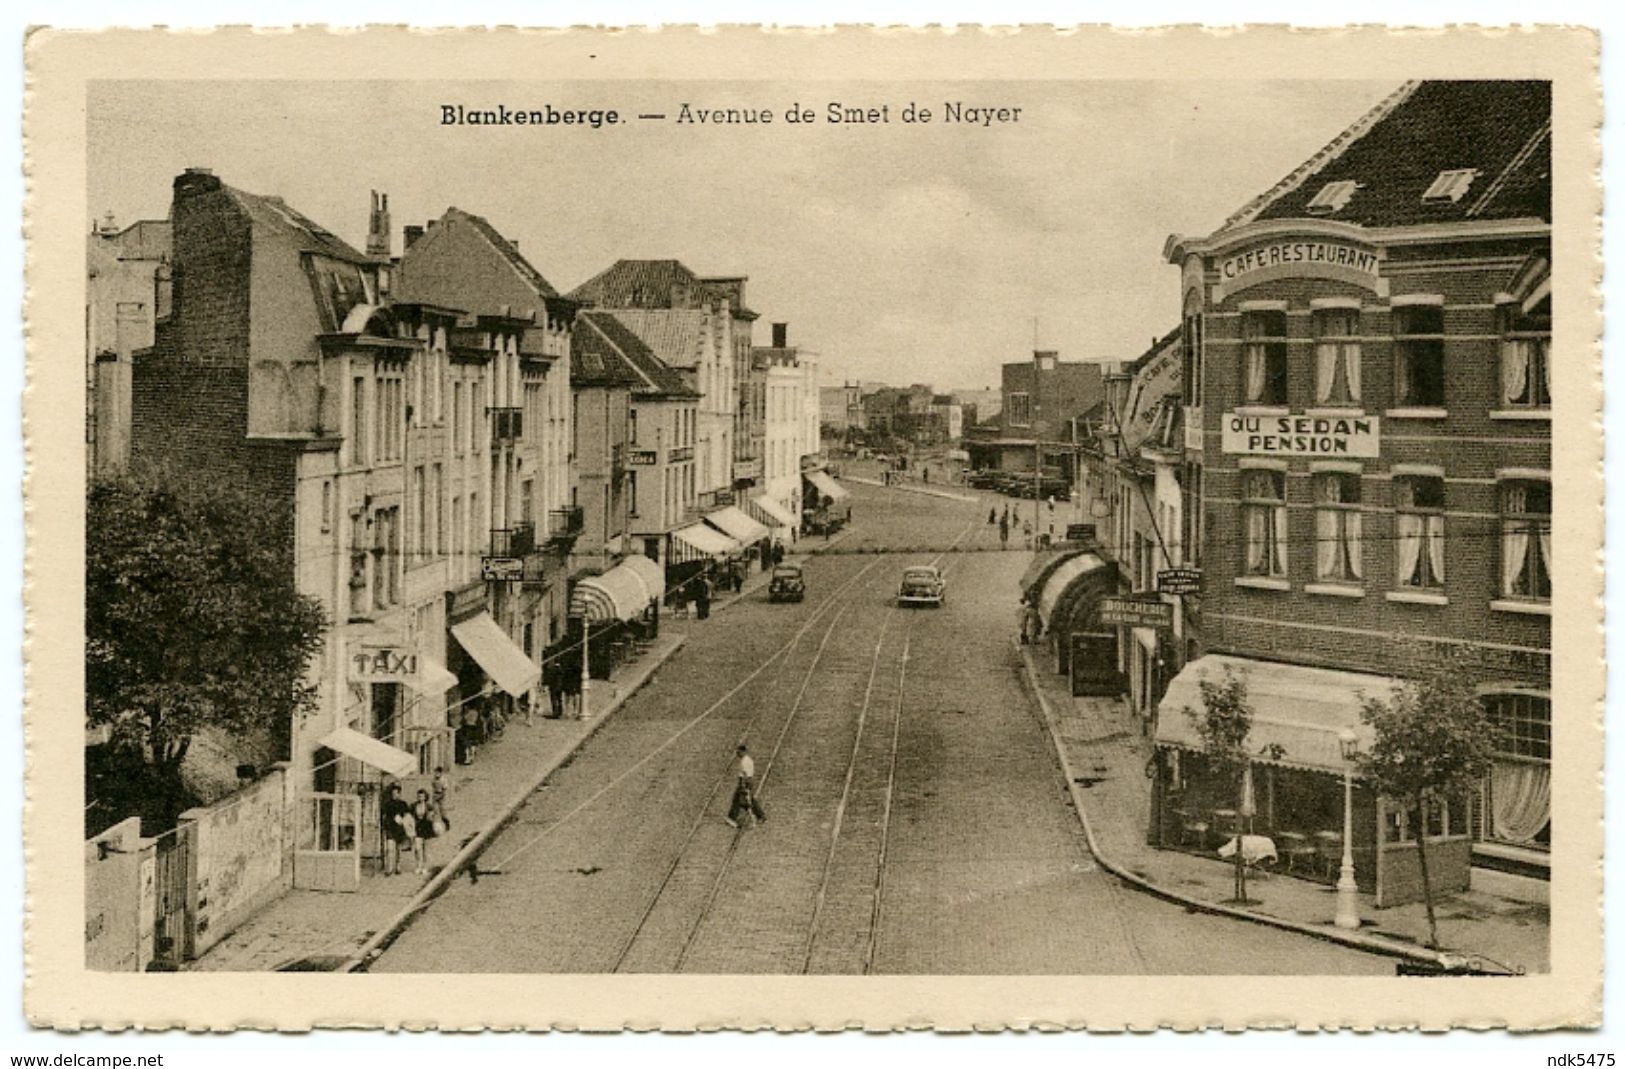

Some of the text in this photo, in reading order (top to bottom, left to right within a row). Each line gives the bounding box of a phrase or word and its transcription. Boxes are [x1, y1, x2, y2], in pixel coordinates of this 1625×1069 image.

[1270, 243, 1377, 272] RESTAURANT
[1277, 418, 1371, 435] SEDAN
[1248, 435, 1347, 453] PENSION
[353, 651, 416, 674] TAXI
